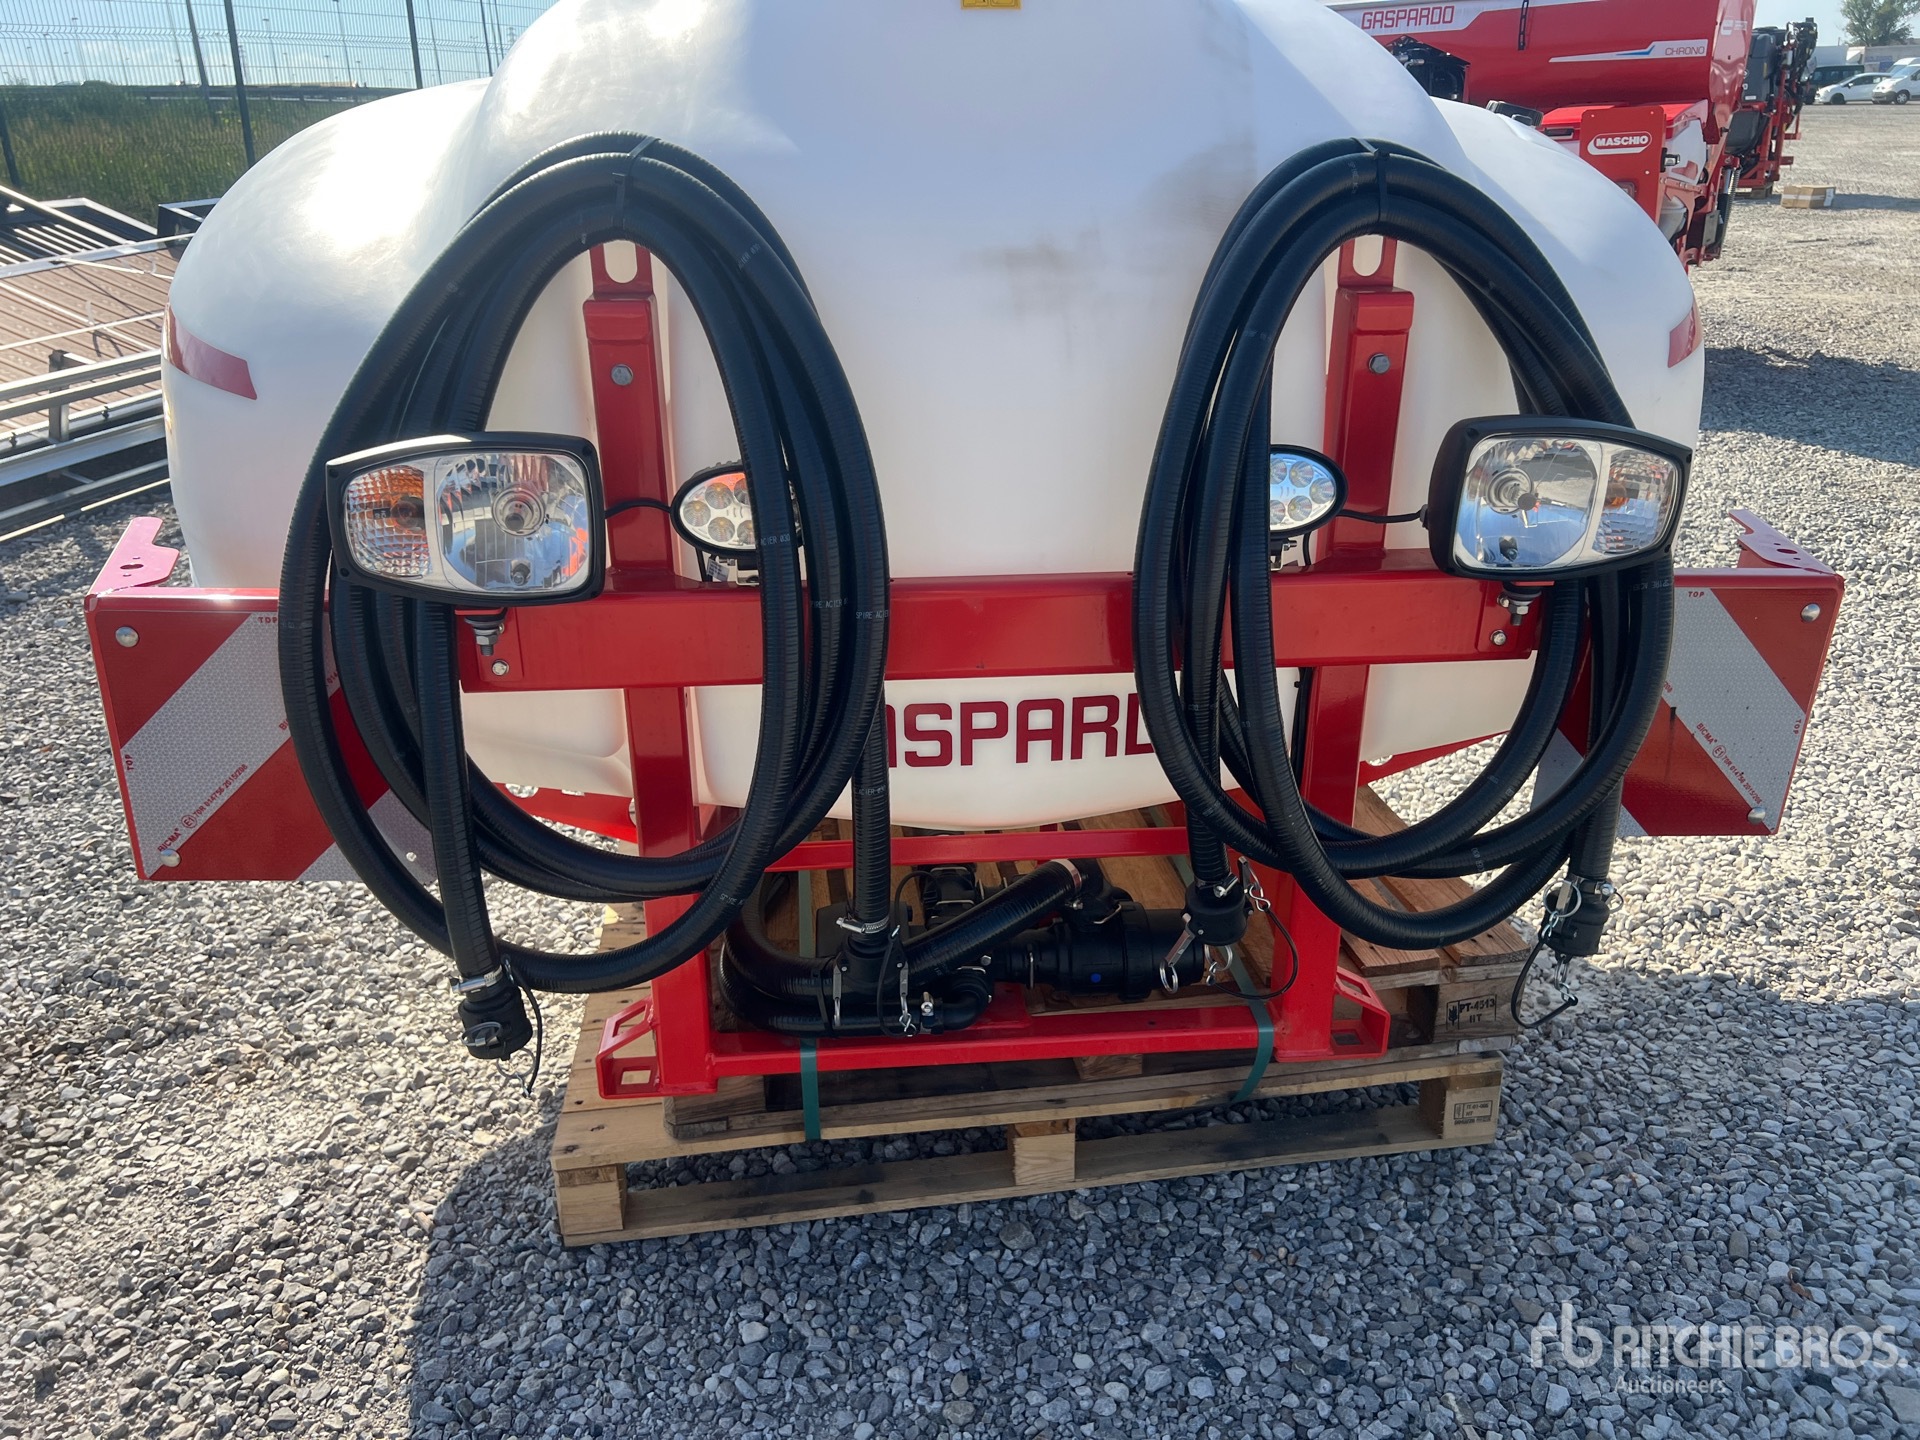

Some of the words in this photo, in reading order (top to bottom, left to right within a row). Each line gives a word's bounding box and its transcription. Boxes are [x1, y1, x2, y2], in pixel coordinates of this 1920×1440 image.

[1361, 5, 1455, 29] GASPARDO
[1665, 46, 1705, 55] CHRONO
[1595, 135, 1649, 147] MASCHIO
[258, 616, 278, 624] TOP
[1793, 719, 1802, 735] TOP
[124, 754, 134, 771] TOP
